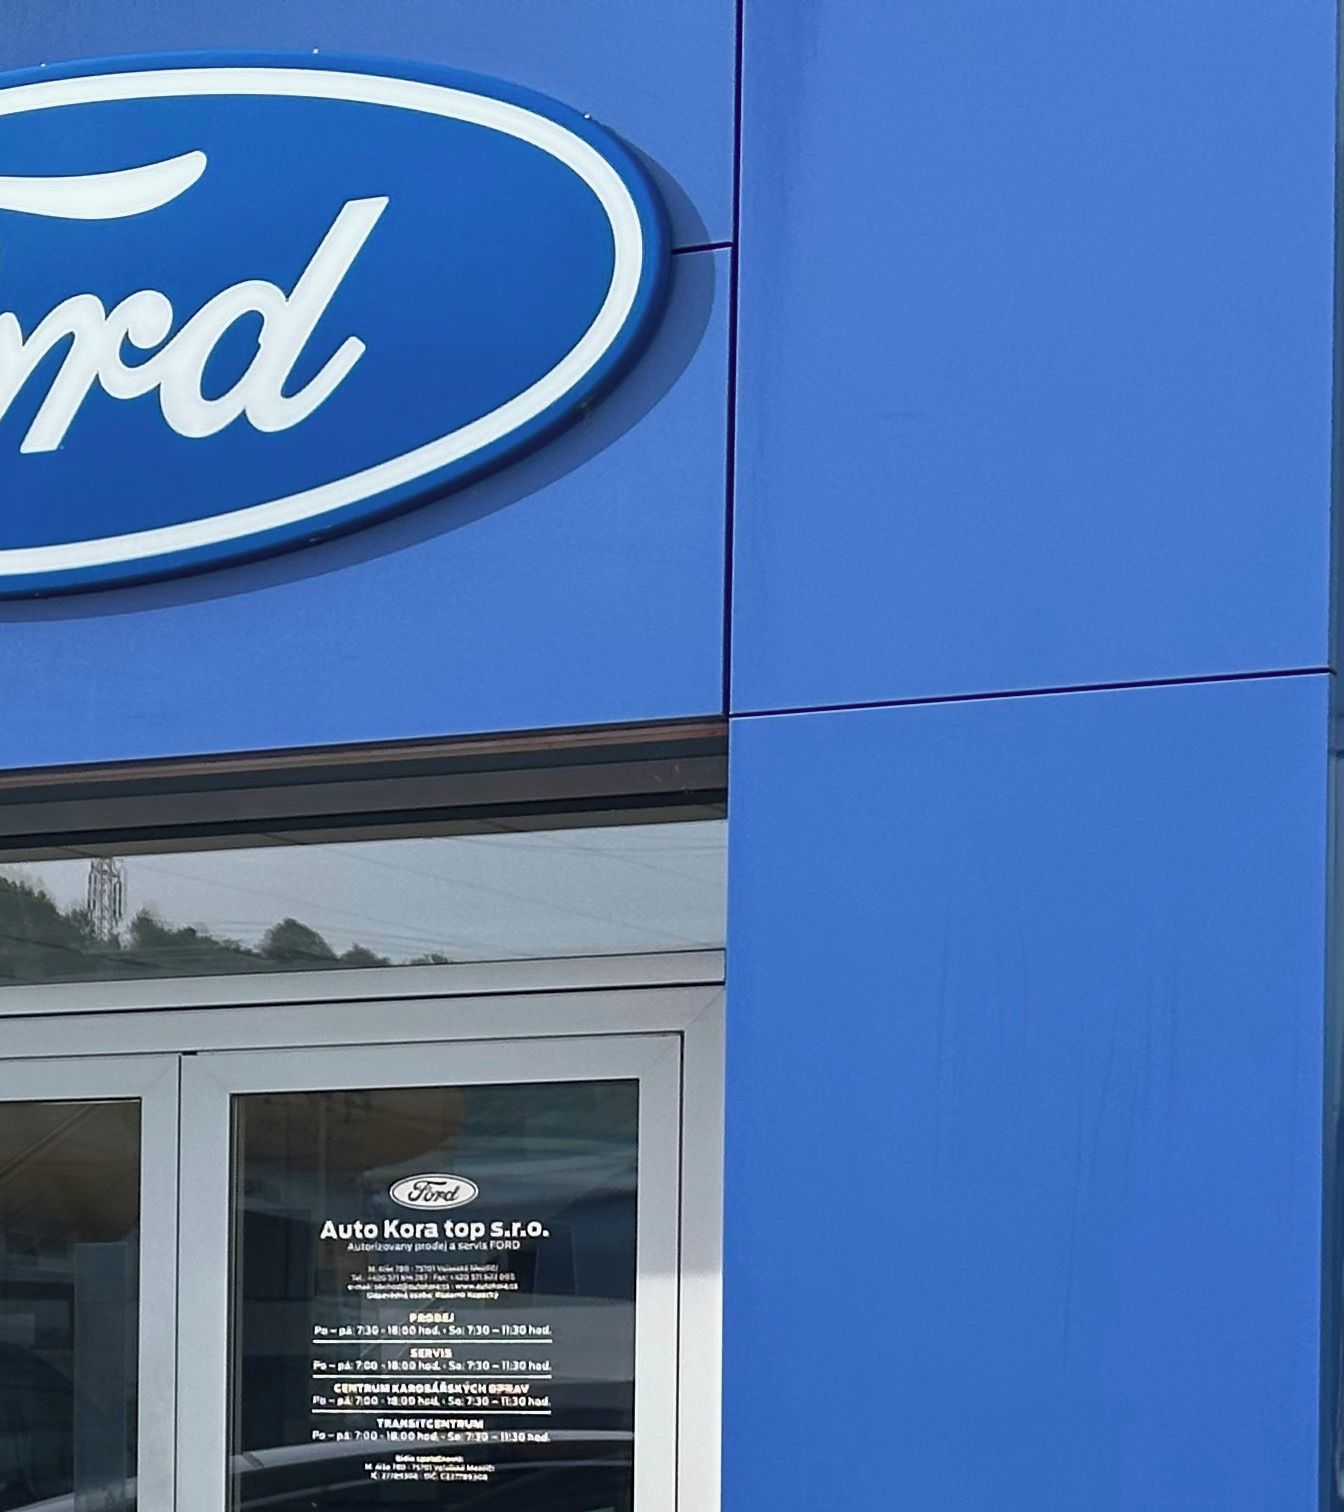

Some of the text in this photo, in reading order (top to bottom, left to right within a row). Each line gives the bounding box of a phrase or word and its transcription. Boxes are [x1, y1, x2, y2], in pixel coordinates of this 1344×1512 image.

[407, 1180, 460, 1202] Ford
[320, 1219, 550, 1241] Auto Kora top s.r.o.
[414, 1241, 448, 1253] prodej
[457, 1241, 488, 1251] servis
[489, 1240, 521, 1250] FORD
[409, 1312, 455, 1323] PRODEJ
[314, 1325, 329, 1336] Po
[409, 1348, 453, 1358] SERVIS
[313, 1360, 327, 1371] Po
[333, 1383, 390, 1393] CENTRUM
[376, 1418, 484, 1429] TRANSITCENTRUM
